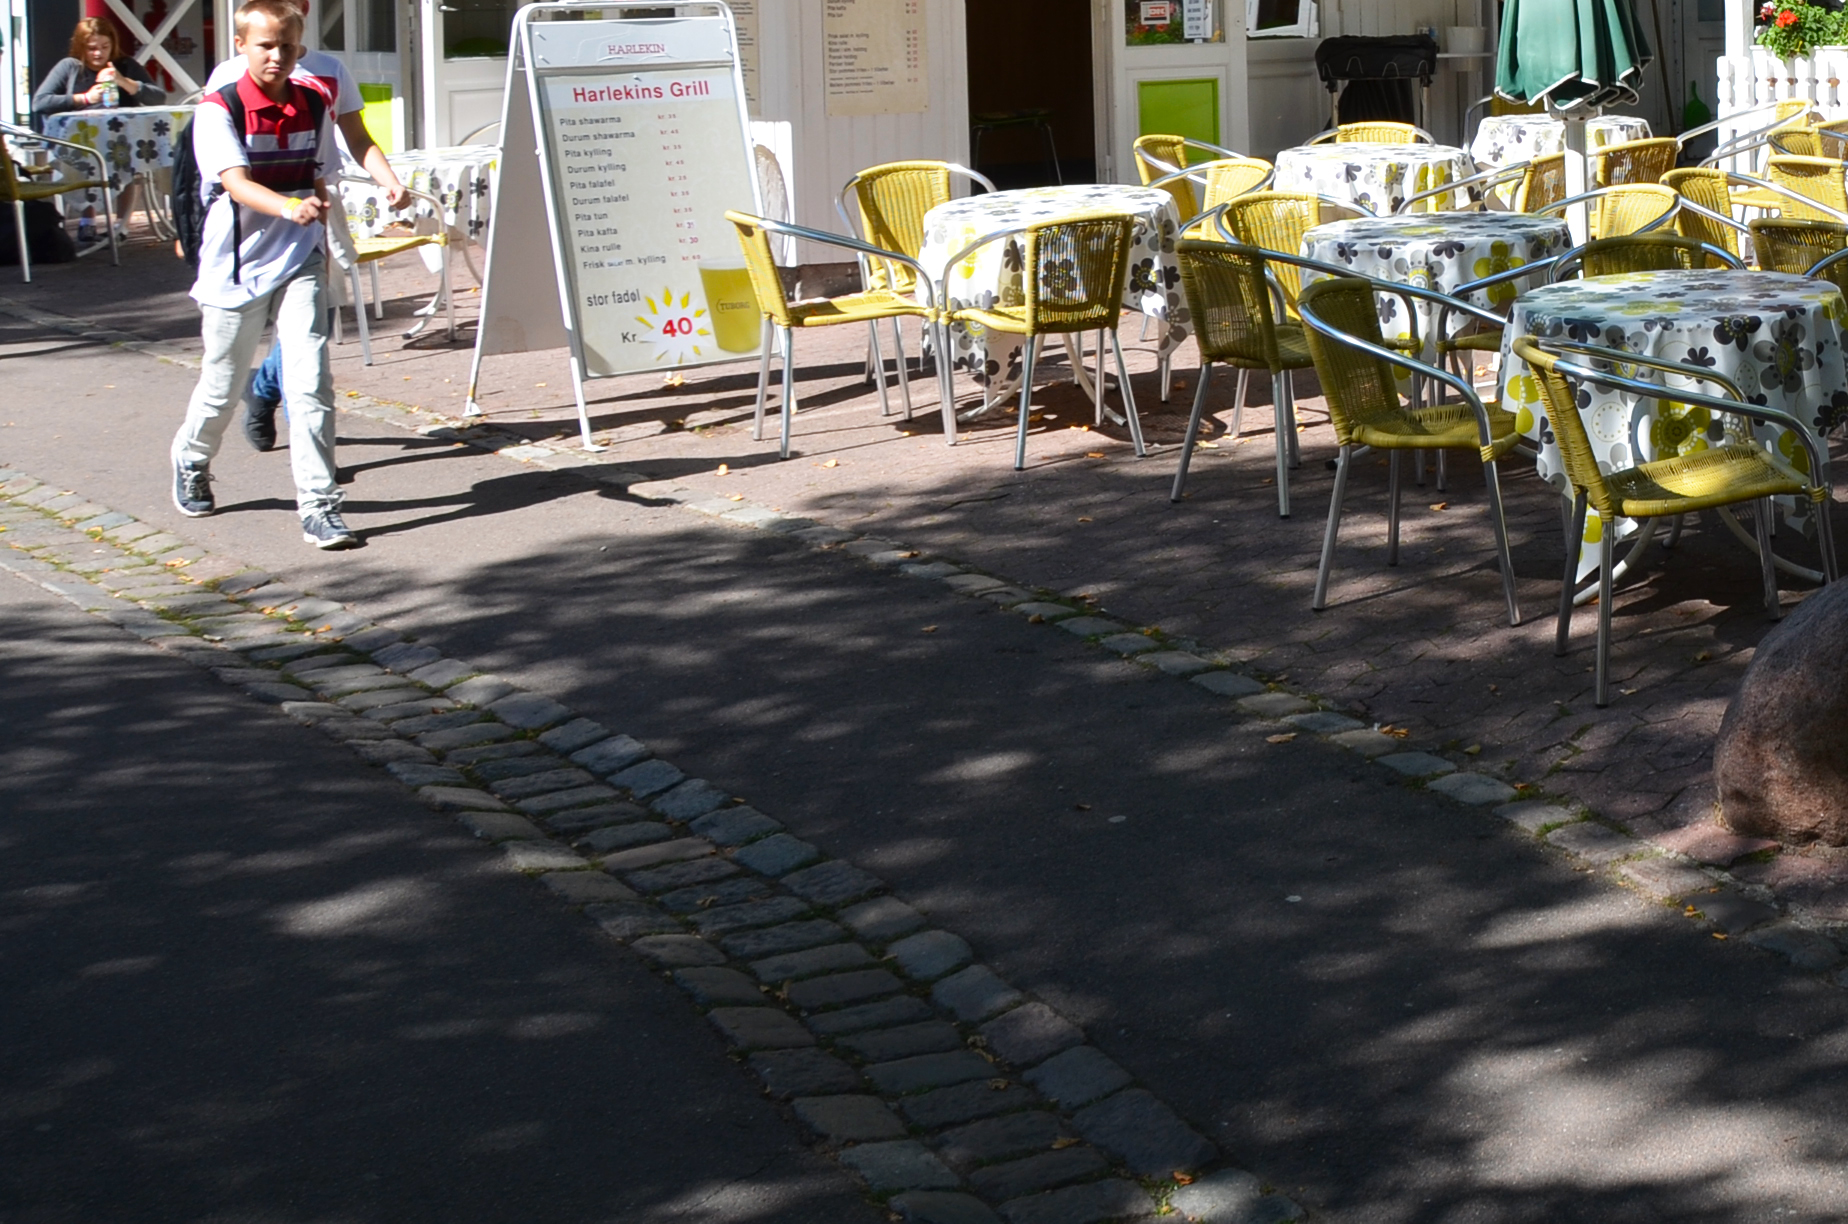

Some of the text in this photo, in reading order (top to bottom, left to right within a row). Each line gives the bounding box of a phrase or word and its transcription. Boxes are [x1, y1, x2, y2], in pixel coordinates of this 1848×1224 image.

[607, 44, 665, 55] HARLEKIN
[573, 80, 709, 104] Harlekins Grill
[560, 116, 621, 126] Pita shawarma
[563, 131, 635, 142] Durum shawarma
[565, 149, 612, 158] Pita kylling
[568, 163, 626, 174] Durum kylling
[587, 289, 640, 307] stor fadøl
[720, 301, 750, 311] TUBORG
[662, 318, 693, 338] 40
[622, 332, 636, 343] Kr
